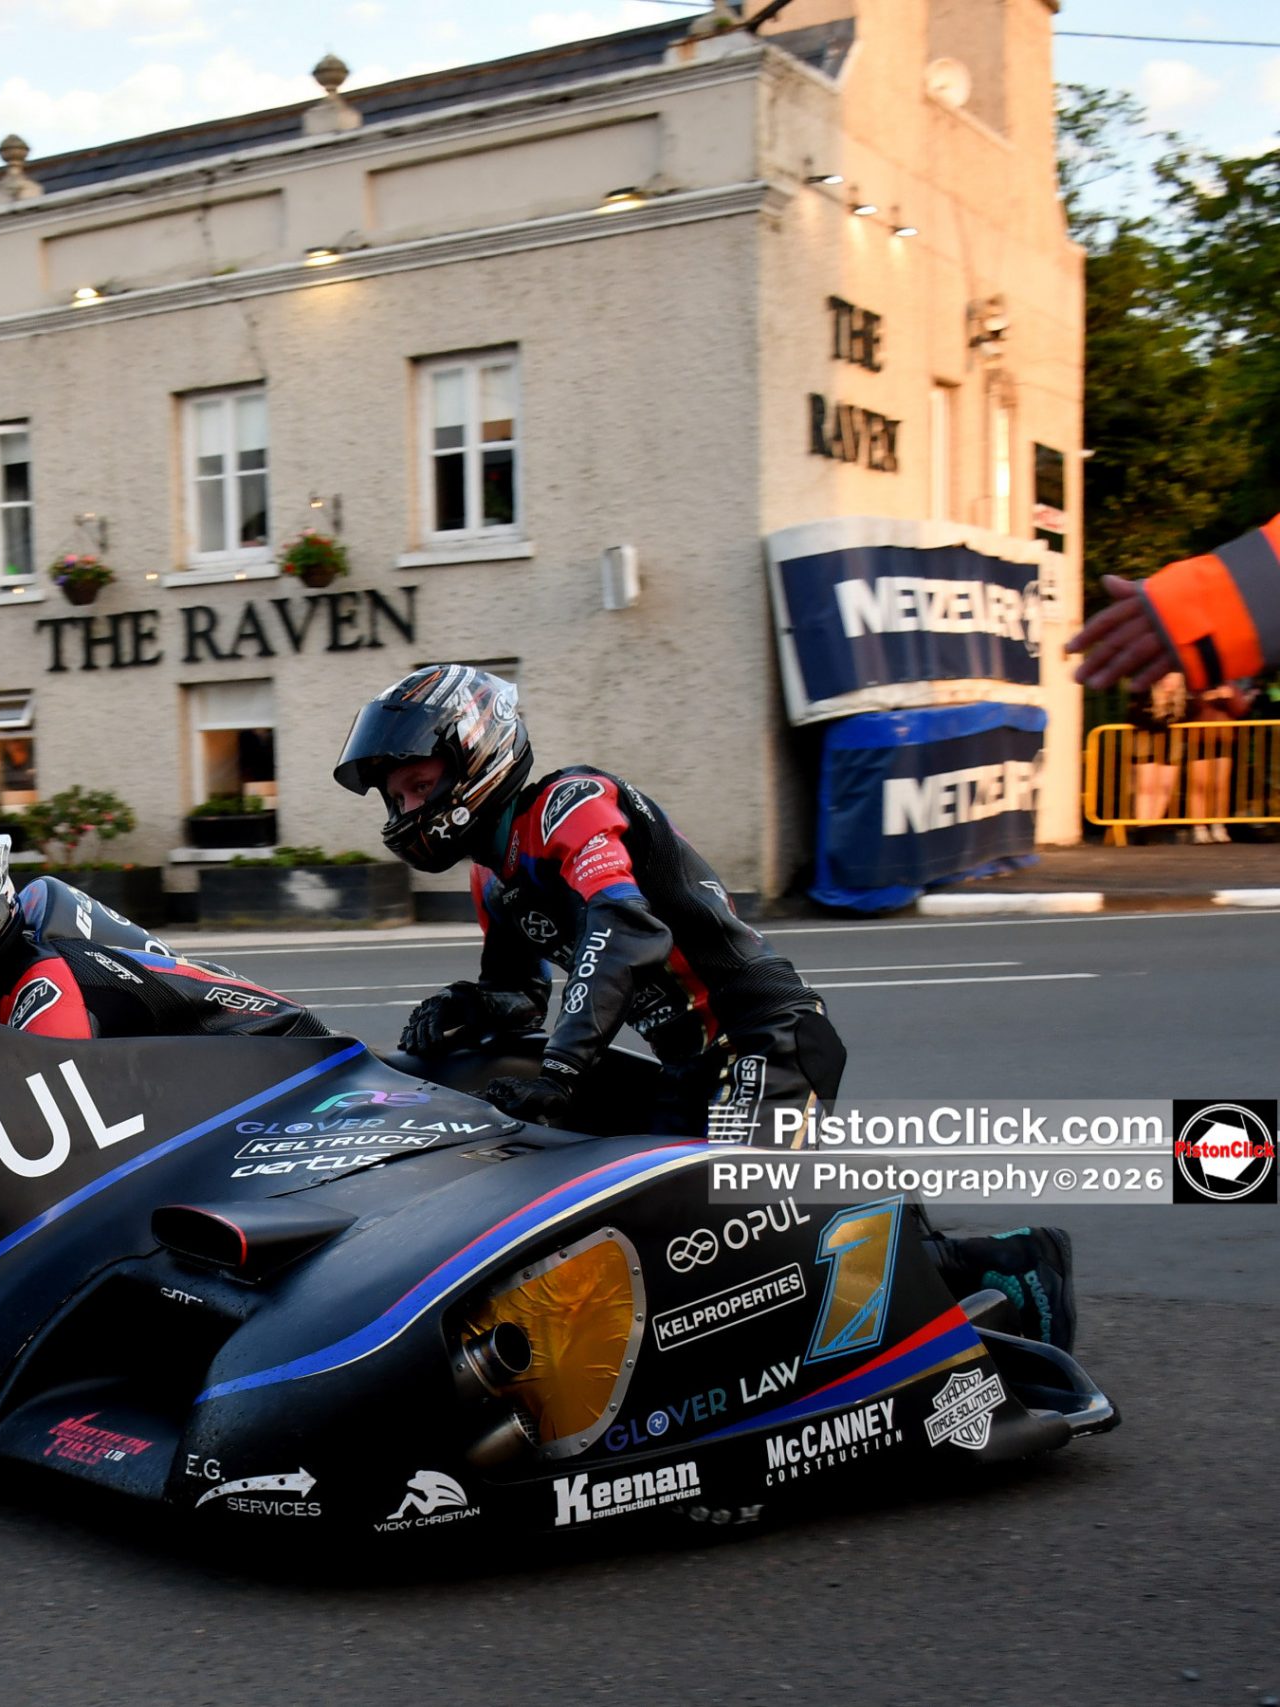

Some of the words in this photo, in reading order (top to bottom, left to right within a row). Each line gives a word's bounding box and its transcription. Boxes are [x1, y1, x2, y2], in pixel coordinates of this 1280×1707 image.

[826, 295, 883, 373] THE
[36, 609, 164, 673] THE
[180, 585, 419, 663] RAVEN
[544, 780, 592, 834] RST
[577, 927, 613, 979] OPUL
[204, 987, 278, 1012] RST
[235, 1117, 387, 1135] GLOVER
[399, 1118, 492, 1136] LAW
[249, 1134, 433, 1154] KELTRUCK
[723, 1196, 811, 1250] OPUL
[657, 1273, 802, 1341] KELPROPERTIES
[803, 1194, 905, 1366] 1
[604, 1387, 728, 1451] GLOVER
[739, 1356, 801, 1404] LAW
[103, 1449, 127, 1462] LTD
[765, 1397, 895, 1470] McCANNEY
[765, 1429, 904, 1487] CONSTRUCTION
[184, 1453, 227, 1483] E.G.
[553, 1460, 701, 1527] Keenan
[226, 1496, 322, 1517] SERVICES
[373, 1519, 413, 1533] VICKY
[415, 1506, 481, 1528] CHRISTIAN
[592, 1497, 657, 1520] construction
[658, 1486, 702, 1505] services
